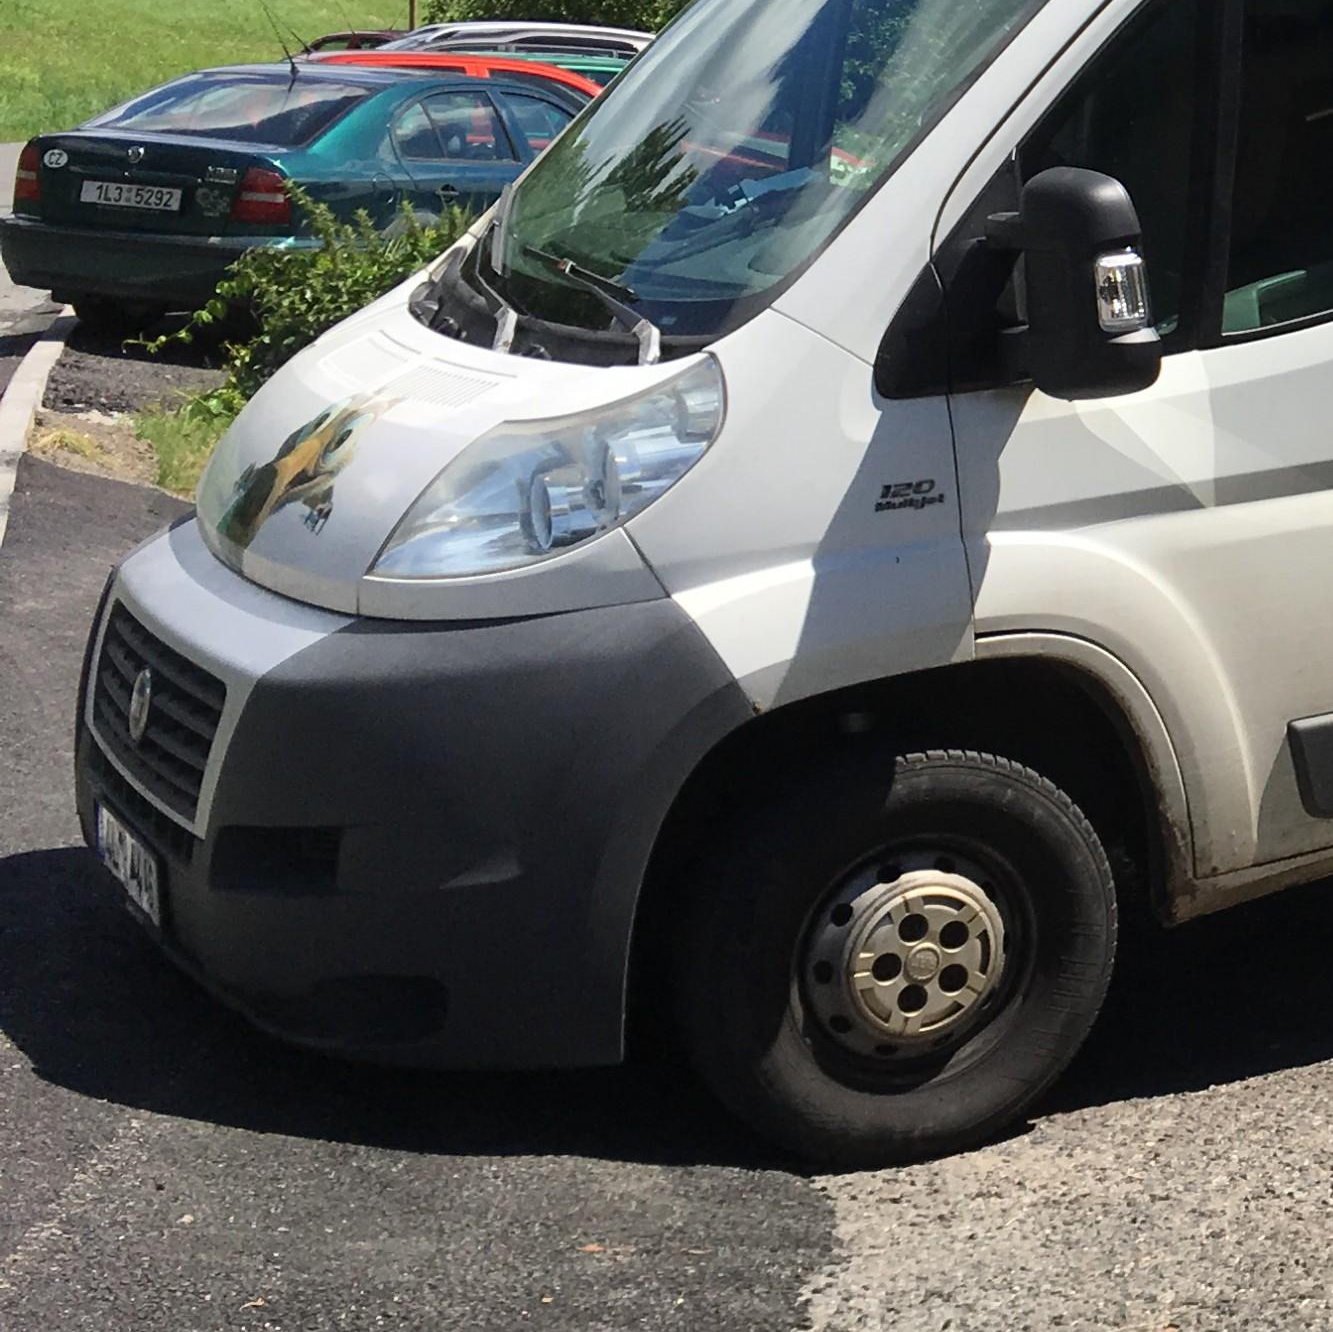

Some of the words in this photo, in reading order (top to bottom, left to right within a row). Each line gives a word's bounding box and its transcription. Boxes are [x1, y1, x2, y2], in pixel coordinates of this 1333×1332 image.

[48, 151, 63, 166] CZ
[96, 184, 123, 203] 1L3
[134, 187, 174, 208] 5292
[880, 479, 936, 499] 120
